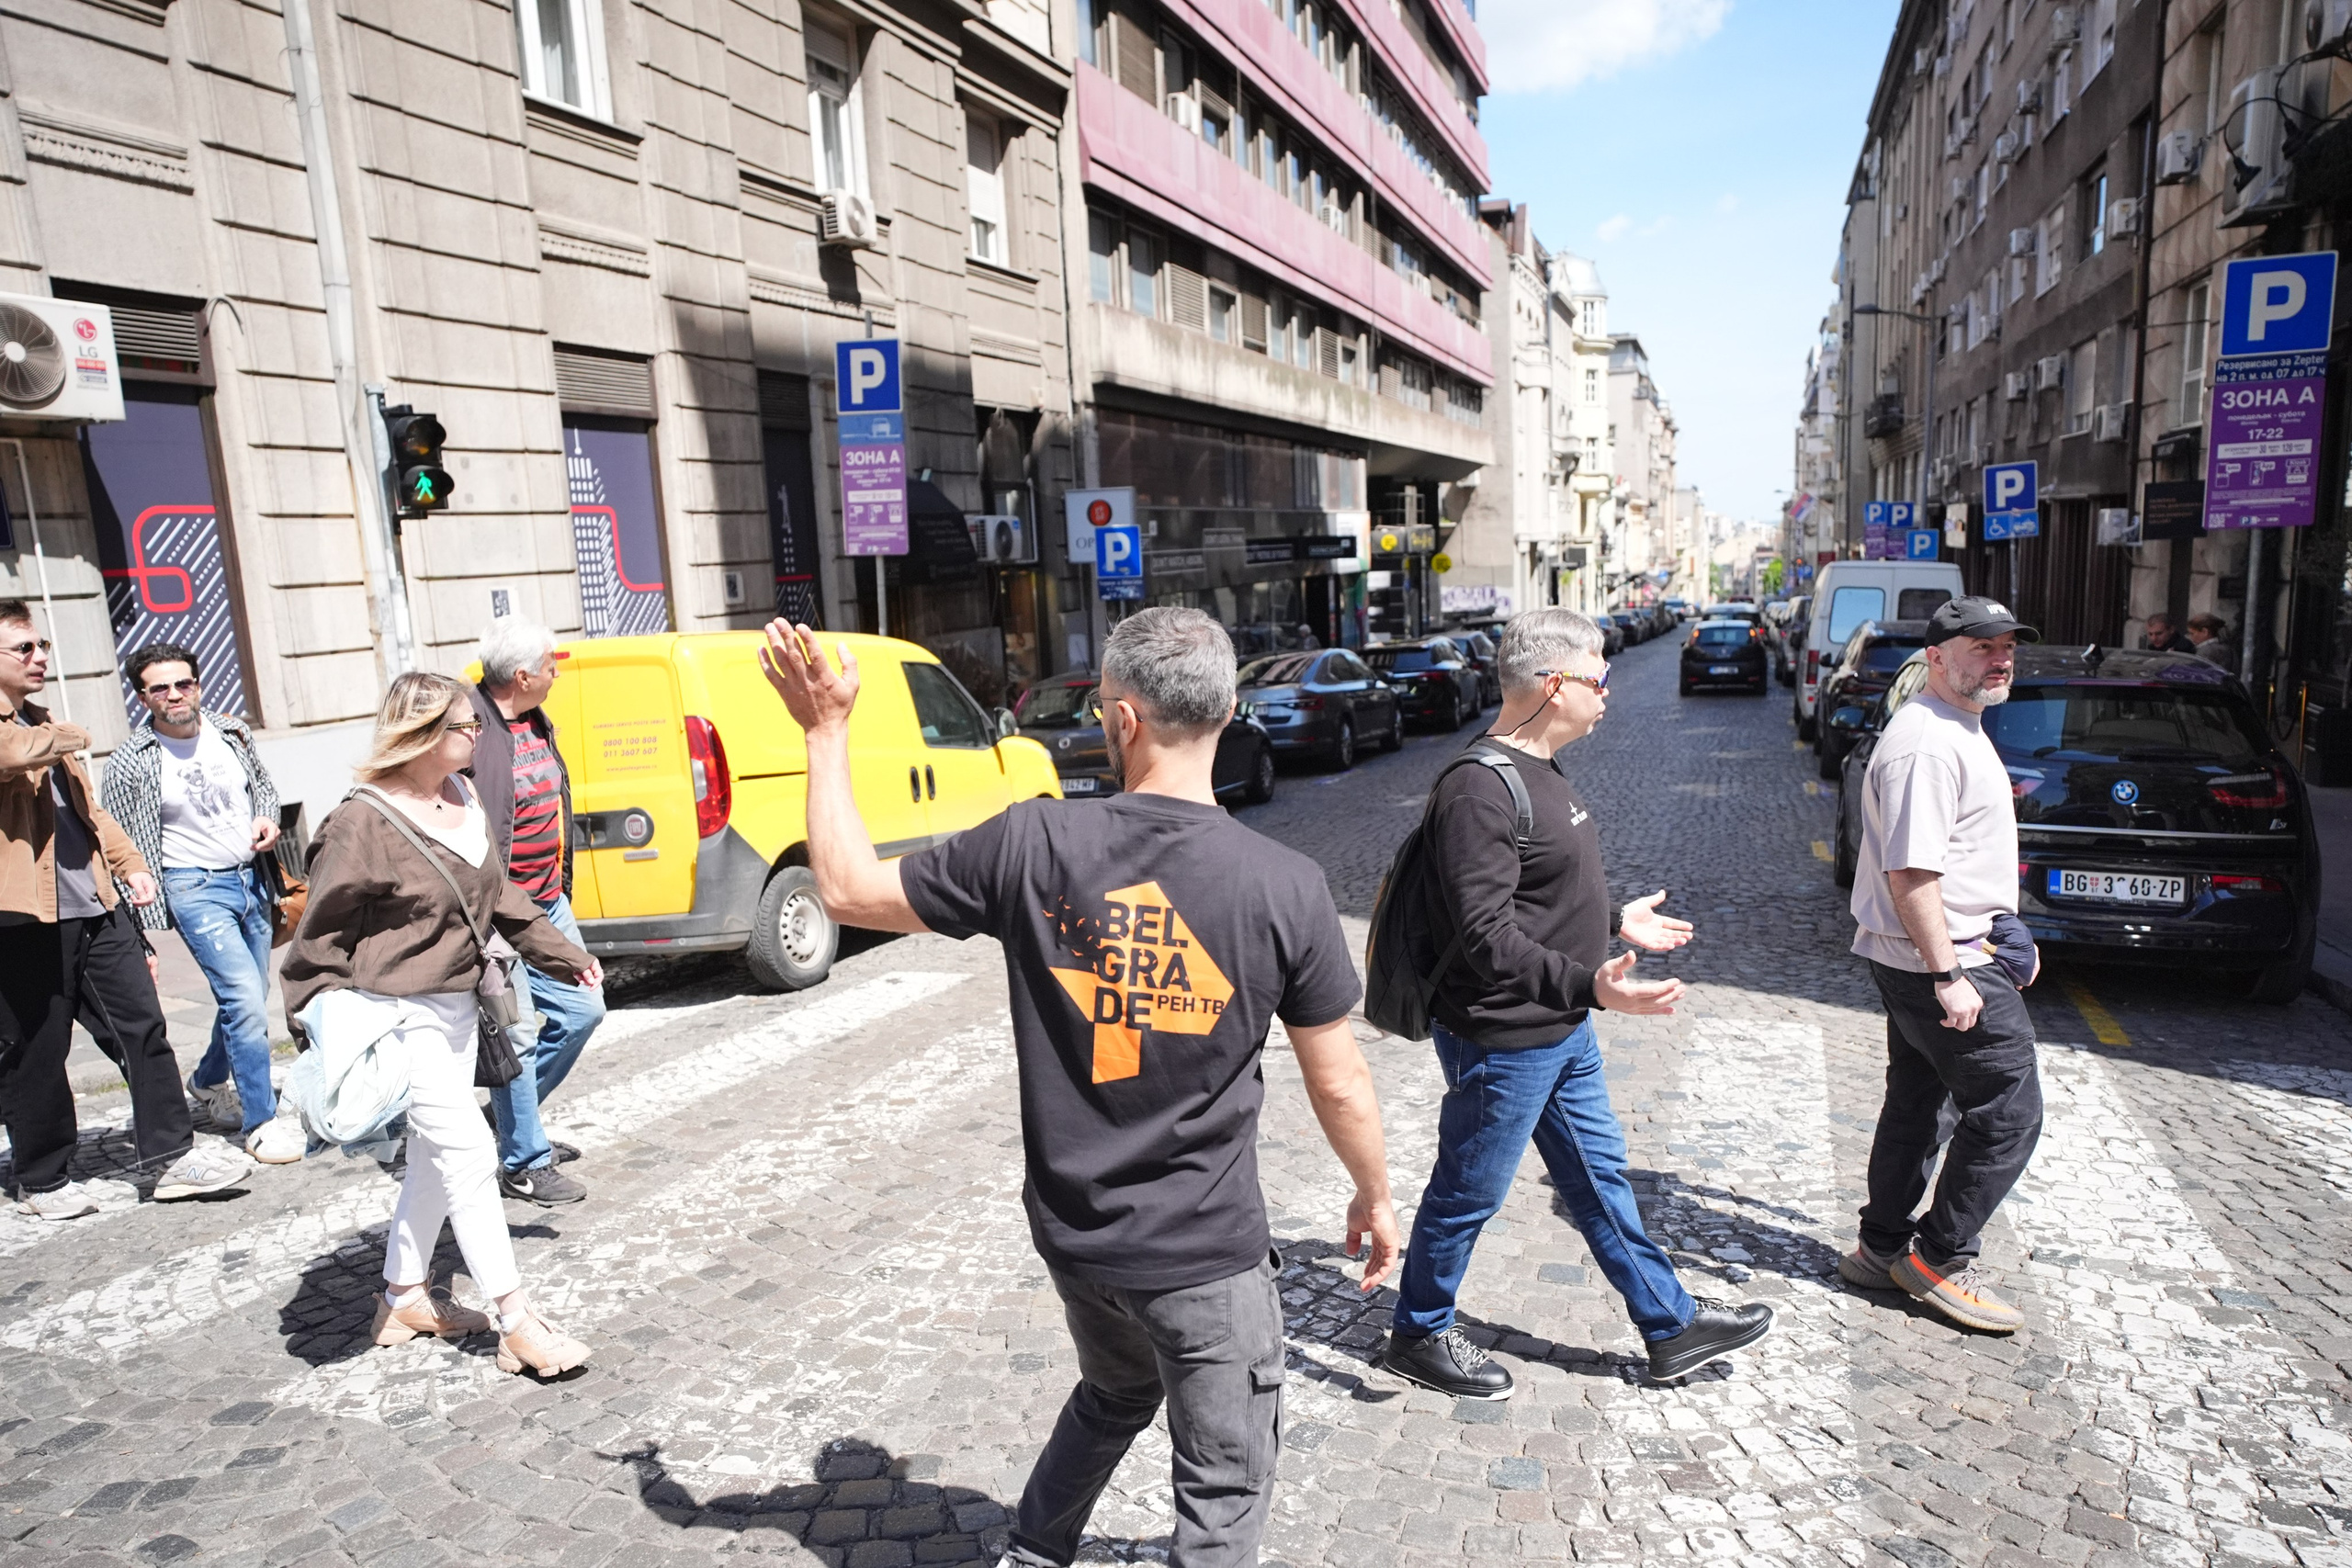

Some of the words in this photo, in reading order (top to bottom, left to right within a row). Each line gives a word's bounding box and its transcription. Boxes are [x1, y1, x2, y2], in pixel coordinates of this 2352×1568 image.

[2247, 270, 2307, 341] P
[79, 345, 98, 358] LG
[2294, 355, 2325, 366] Zepter
[850, 348, 886, 404] P
[2230, 372, 2236, 381] 2
[2276, 368, 2290, 378] 07
[2307, 367, 2317, 376] 17
[2222, 388, 2290, 409] ЗОНА
[2248, 427, 2284, 440] 17-22
[846, 450, 886, 466] ЗОНА
[1996, 469, 2025, 508] P
[1869, 503, 1883, 522] P
[1892, 505, 1908, 525] P
[1104, 532, 1131, 572] P
[1914, 534, 1931, 556] P
[604, 739, 622, 747] 0800
[642, 736, 657, 744] 808
[604, 750, 616, 758] 011
[621, 749, 639, 757] 3607
[643, 747, 658, 755] 607
[2064, 874, 2087, 892] BG
[1102, 901, 1188, 948] BEL
[1097, 944, 1192, 992] GRA
[1094, 986, 1154, 1031] DE
